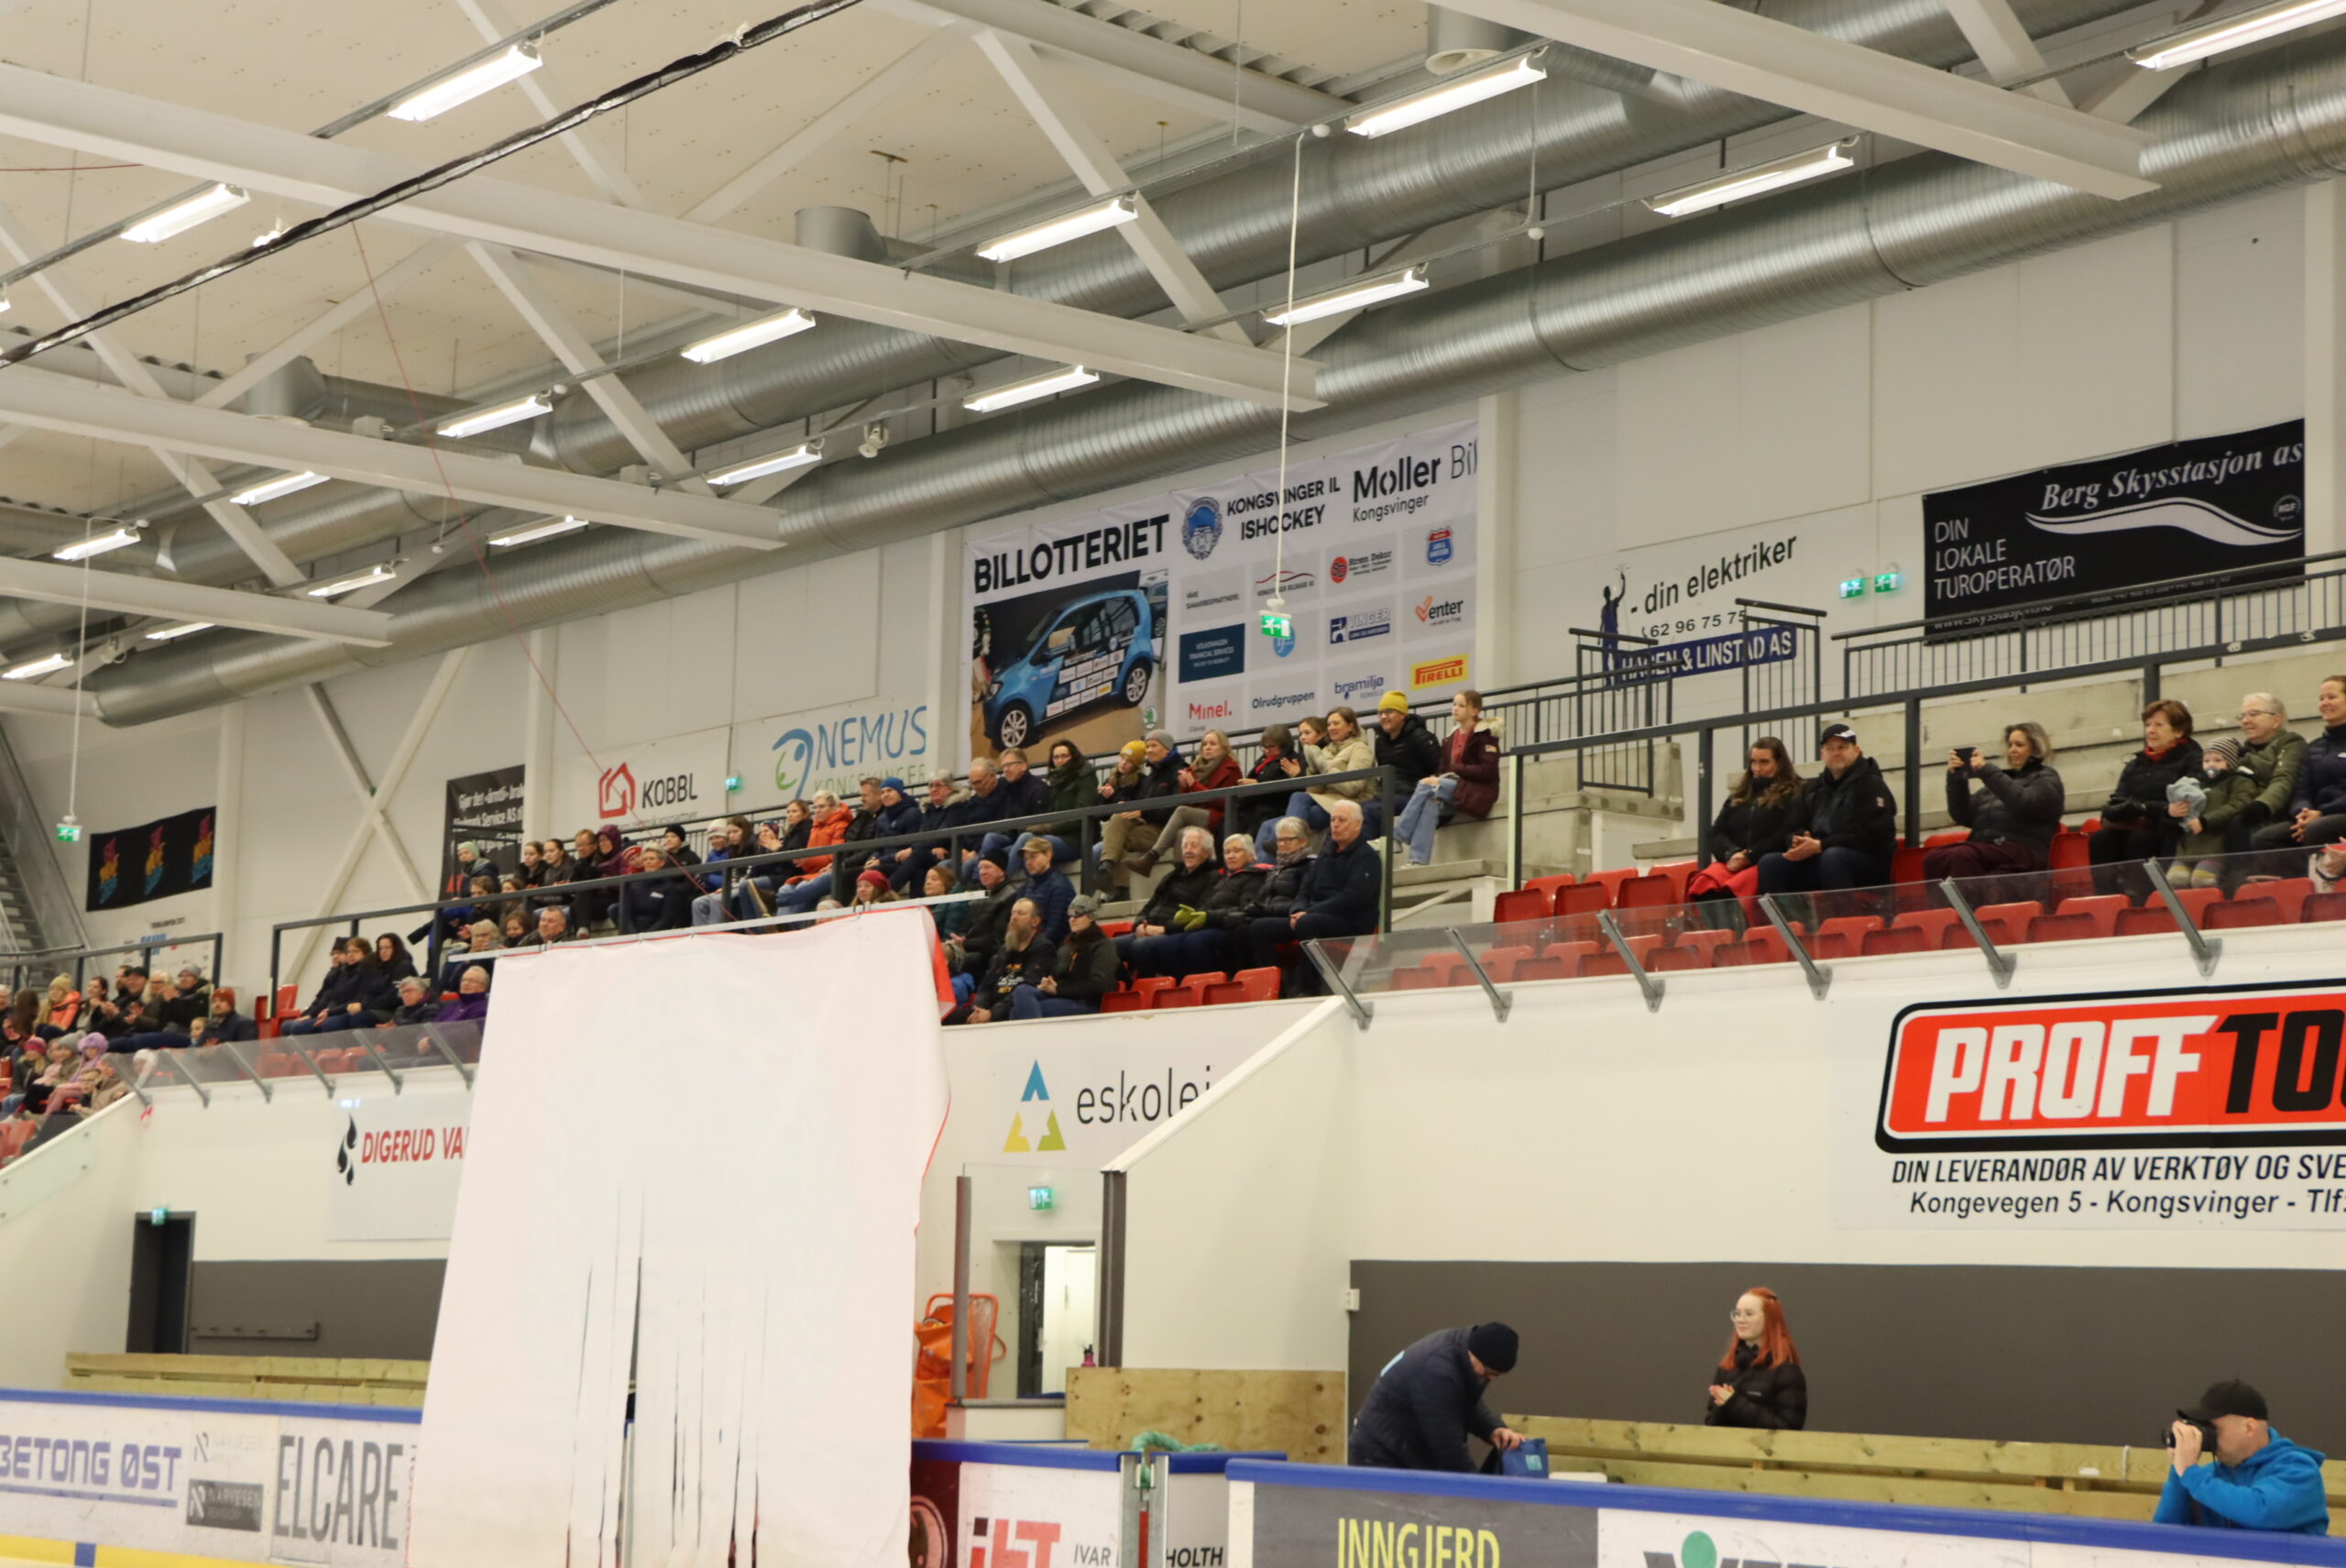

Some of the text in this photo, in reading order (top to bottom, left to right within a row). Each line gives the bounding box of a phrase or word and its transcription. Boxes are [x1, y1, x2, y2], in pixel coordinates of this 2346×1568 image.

[1451, 439, 1477, 479] Bil
[2040, 443, 2303, 511] Berg Skysstasjon as
[1226, 476, 1341, 517] KONGSVINGER IL
[1353, 494, 1430, 522] Kongsvinger
[1240, 504, 1326, 541] ISHOCKEY
[1934, 518, 1969, 543] DIN
[974, 513, 1170, 594] BILLOTTERIET
[1935, 538, 2007, 572] LOKALE
[1644, 581, 1679, 615] din
[1687, 535, 1797, 598] elektriker
[1934, 555, 2076, 600] TUROPERATØR
[1349, 608, 1392, 629] VINGER
[1650, 609, 1747, 638] 62 96 75 75
[1681, 647, 1694, 672] &
[1769, 630, 1792, 655] AS
[1415, 659, 1464, 685] PIRELLI
[816, 705, 927, 771] NEMUS
[641, 773, 698, 808] KOBBL
[361, 1126, 469, 1164] DIGERUD VA
[1892, 1159, 1930, 1183] DIN
[1935, 1157, 2088, 1183] LEVERANDØR
[2092, 1156, 2126, 1181] AV
[2133, 1154, 2250, 1181] VERKTØY
[2255, 1154, 2290, 1180] OG
[1910, 1190, 2059, 1219] Kongevegen
[2068, 1190, 2082, 1213] 5
[2106, 1189, 2279, 1220] Kongsvinger
[120, 1442, 182, 1492] ØST
[275, 1434, 404, 1551] ELCARE
[1073, 1544, 1112, 1566] IVAR
